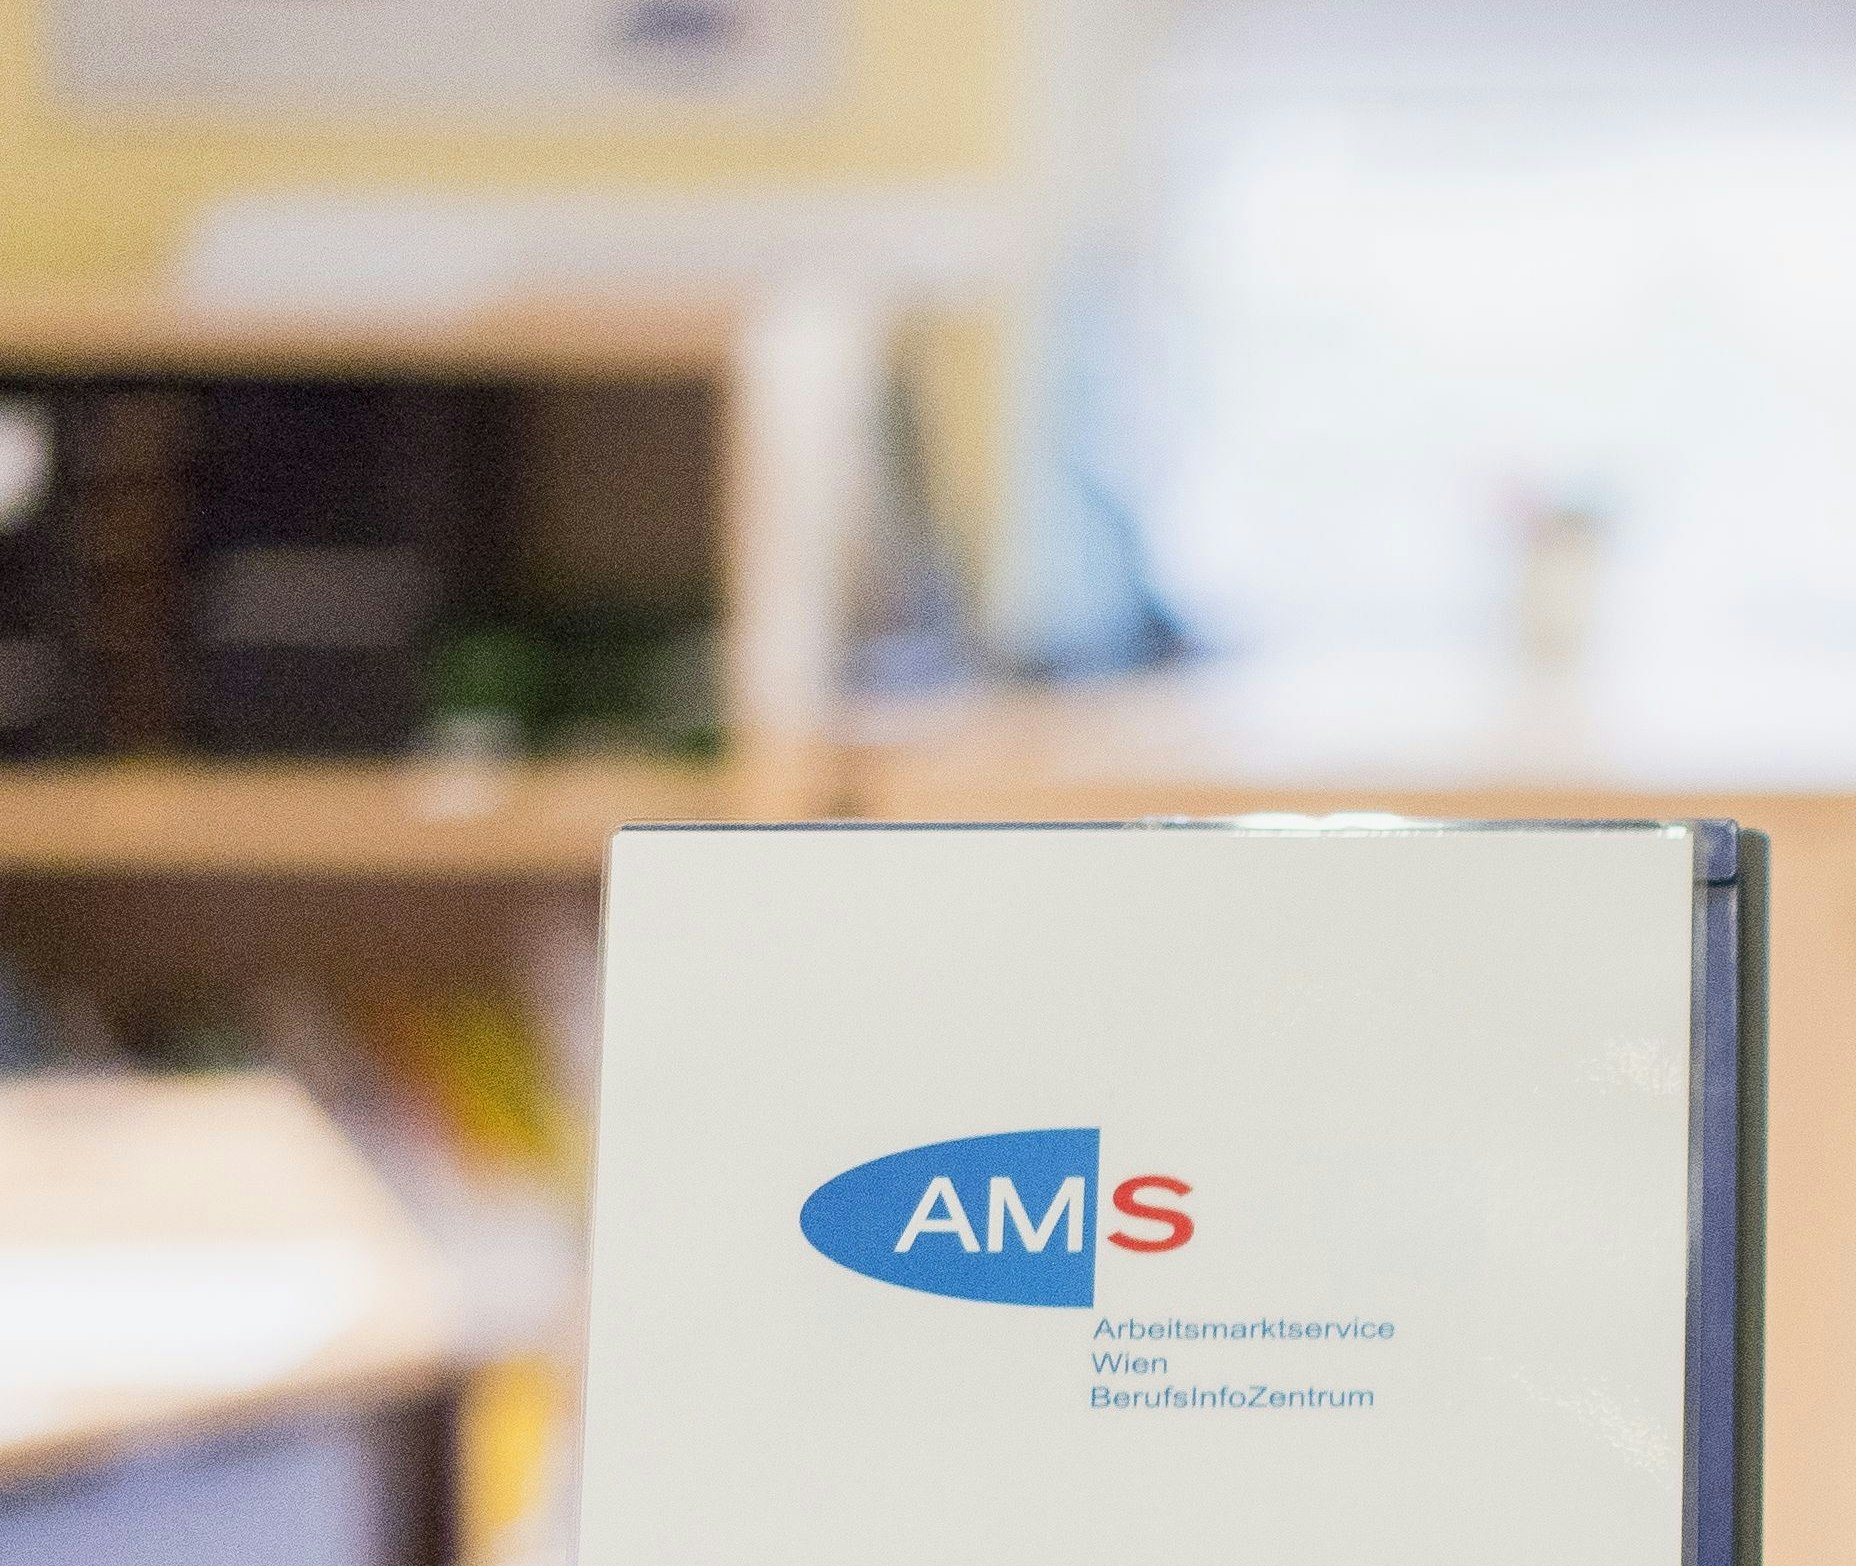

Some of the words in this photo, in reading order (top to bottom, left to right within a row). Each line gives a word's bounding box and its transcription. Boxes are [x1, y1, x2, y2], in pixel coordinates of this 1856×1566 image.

[895, 1173, 1195, 1255] AMS
[1094, 1318, 1395, 1340] Arbeitsmarktservice
[1092, 1352, 1167, 1374] Wien
[1091, 1386, 1374, 1408] BerufsInfoZentrum
